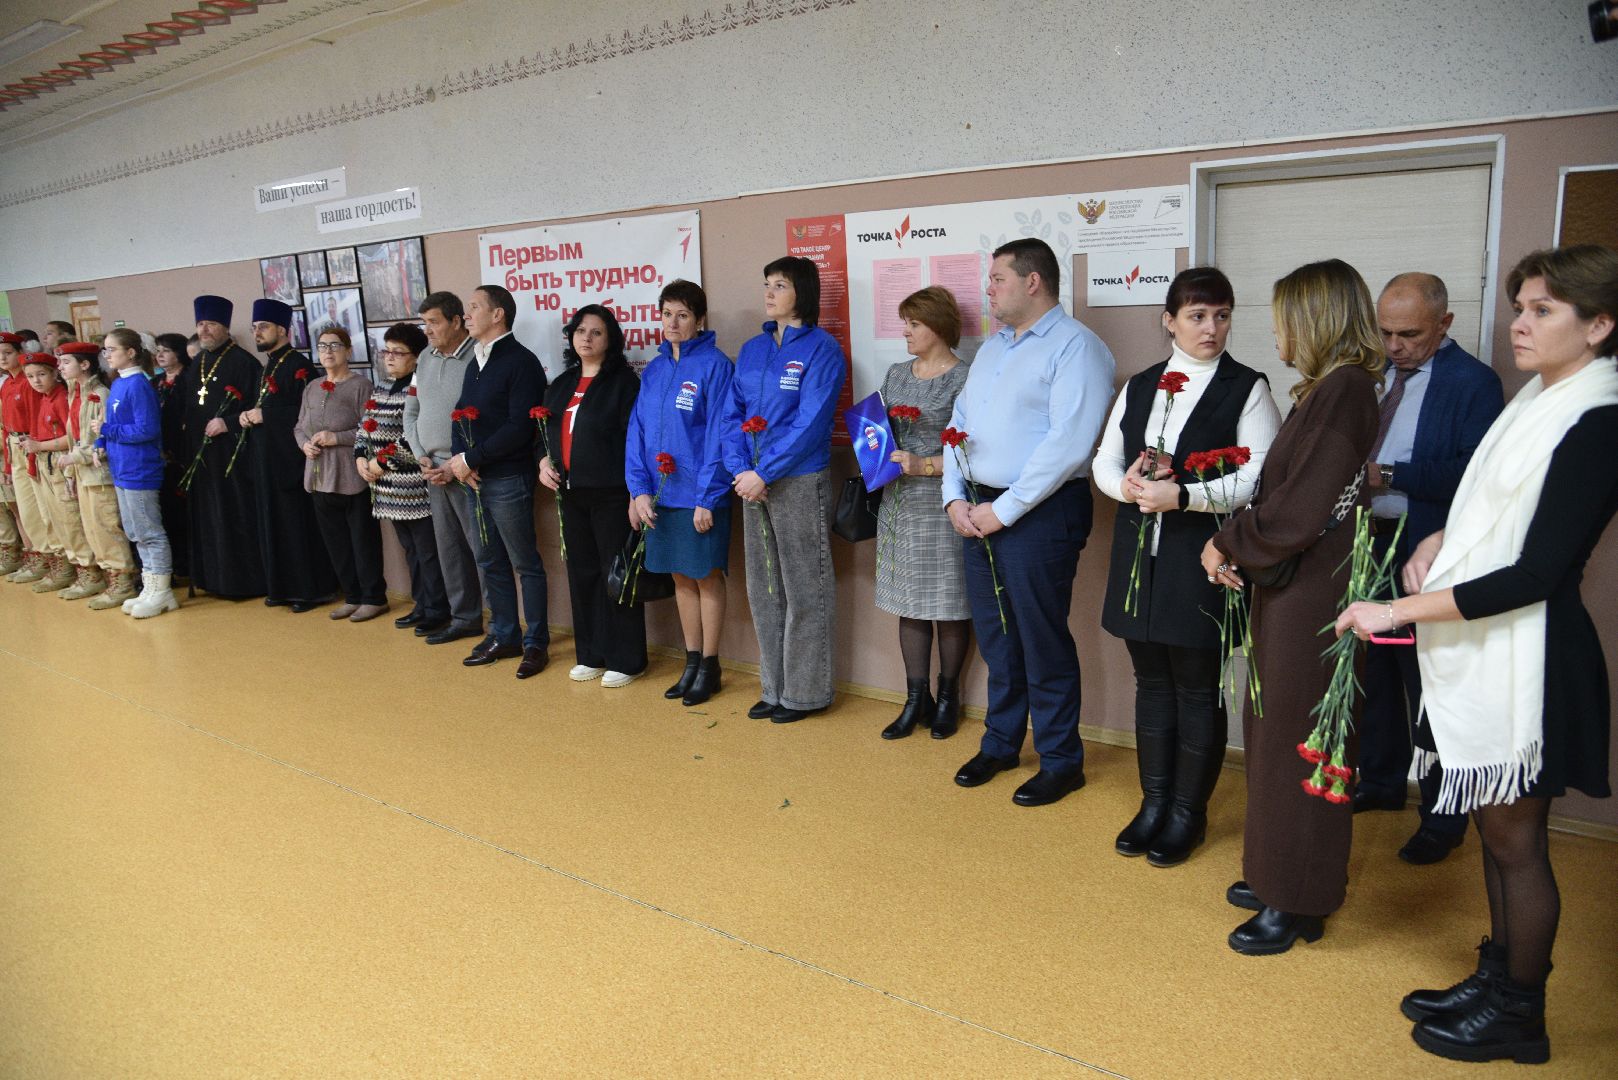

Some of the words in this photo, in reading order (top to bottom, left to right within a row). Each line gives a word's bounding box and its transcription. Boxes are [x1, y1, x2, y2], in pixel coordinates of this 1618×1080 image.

[258, 187, 288, 204] Ваши
[290, 178, 329, 203] успехи
[320, 206, 353, 225] наша
[355, 191, 417, 222] гордость!
[857, 231, 893, 243] ТОЧКА
[911, 227, 947, 239] РОСТА
[489, 242, 583, 270] Первым
[505, 268, 563, 292] быть
[565, 264, 663, 293] трудно,
[1092, 278, 1123, 286] ТОЧКА
[1139, 275, 1169, 284] РОСТА
[534, 293, 561, 311] но
